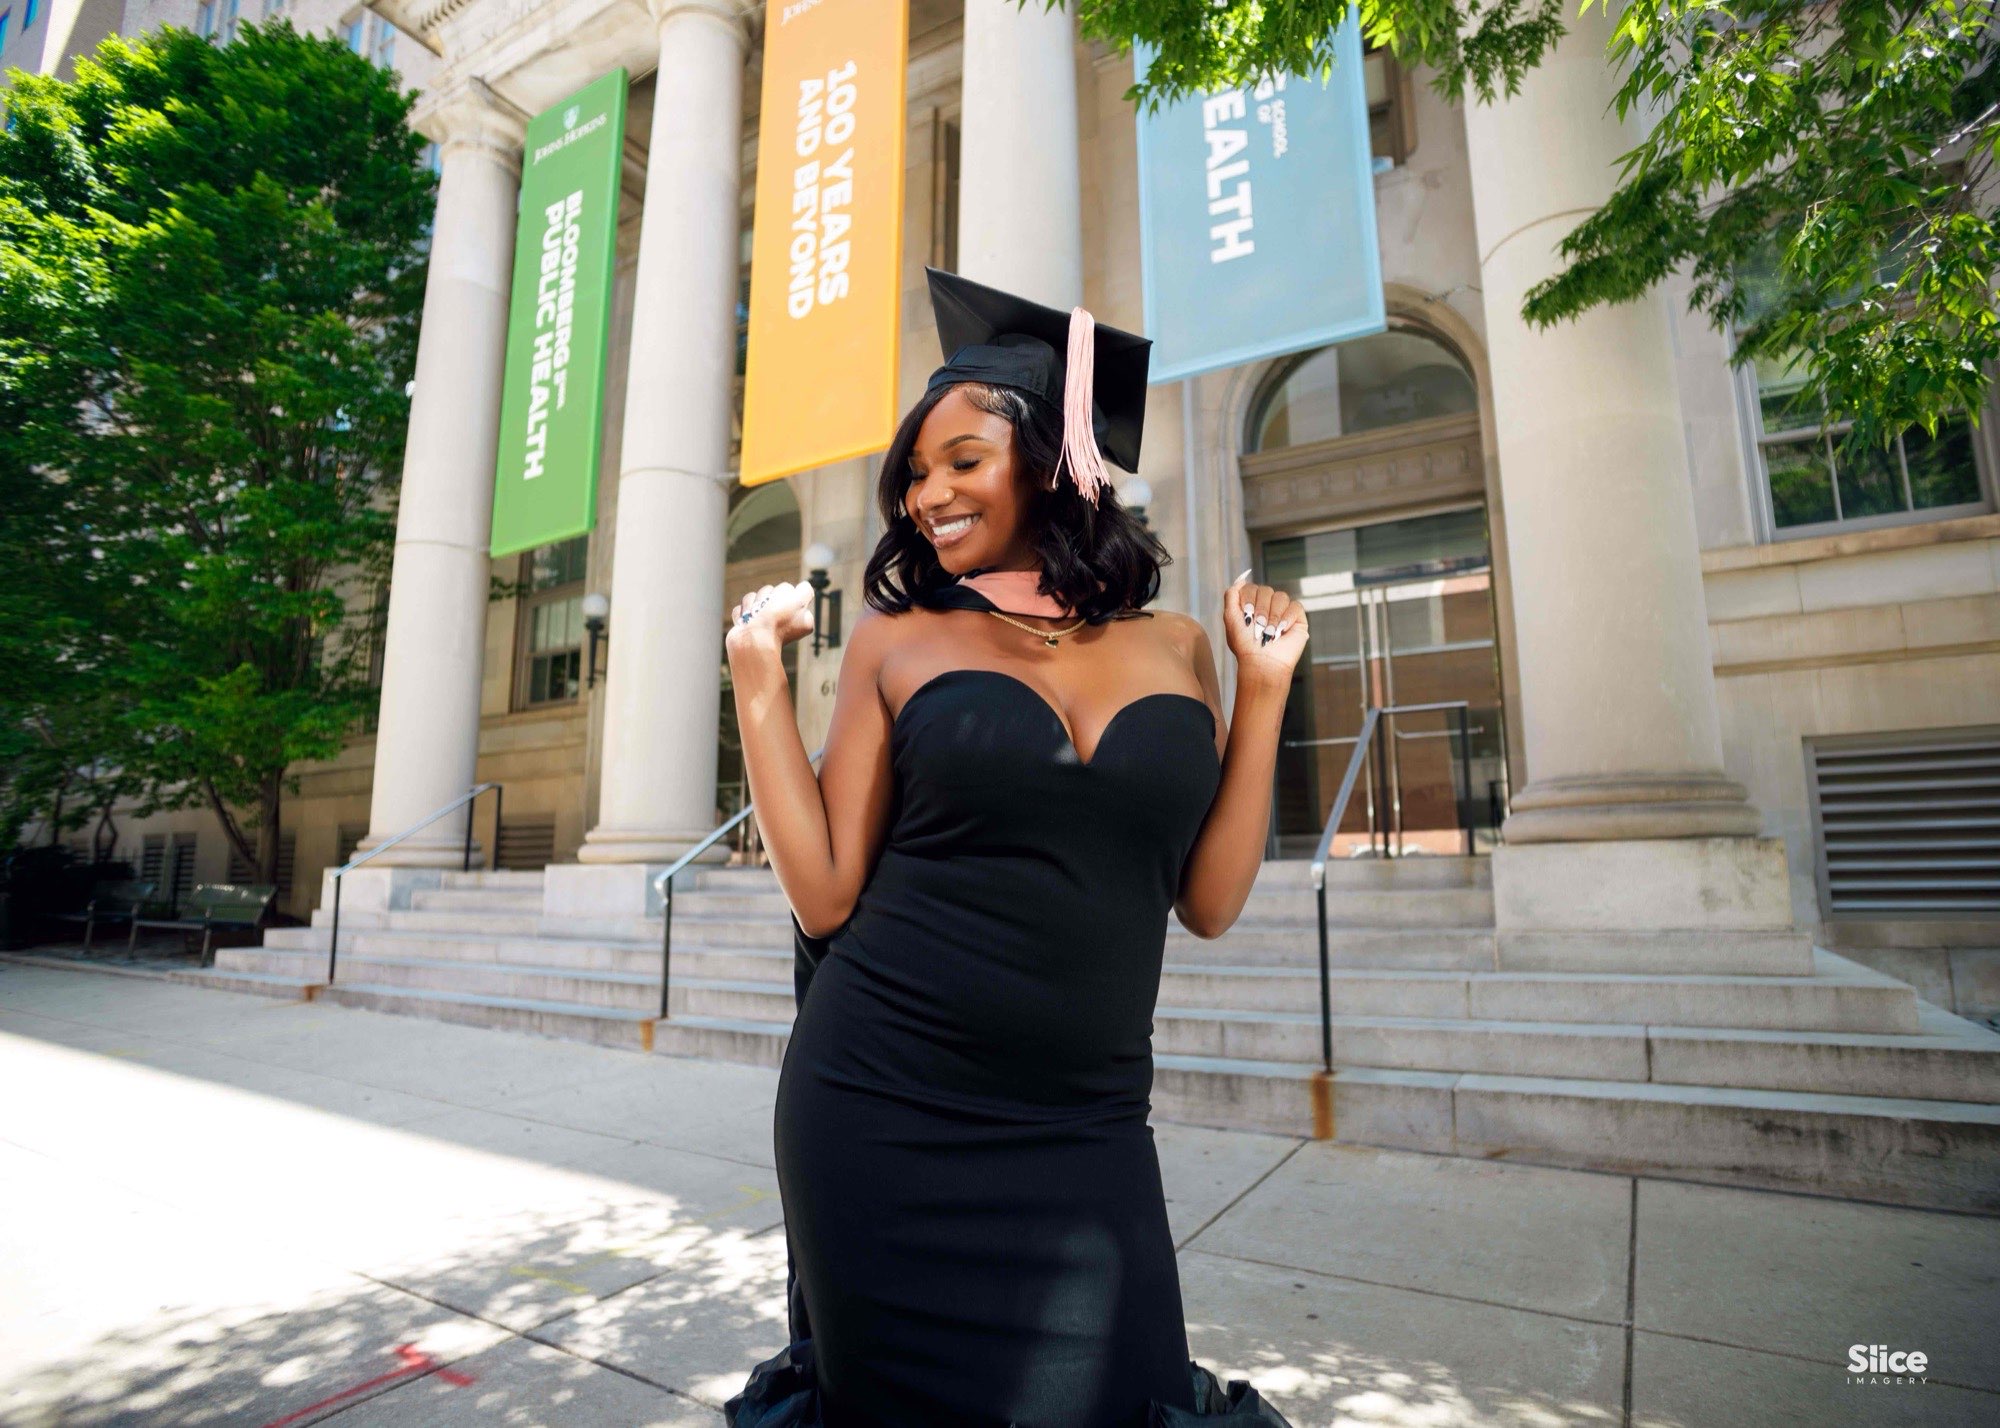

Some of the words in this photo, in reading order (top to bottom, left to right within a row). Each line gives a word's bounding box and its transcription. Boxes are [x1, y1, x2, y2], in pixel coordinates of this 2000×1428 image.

[796, 79, 824, 157] AND
[824, 60, 857, 146] 100
[1202, 84, 1256, 264] EALTH
[536, 199, 565, 329] PUBLIC
[788, 160, 820, 320] BEYOND
[818, 147, 854, 306] YEARS
[523, 331, 554, 480] HEALTH
